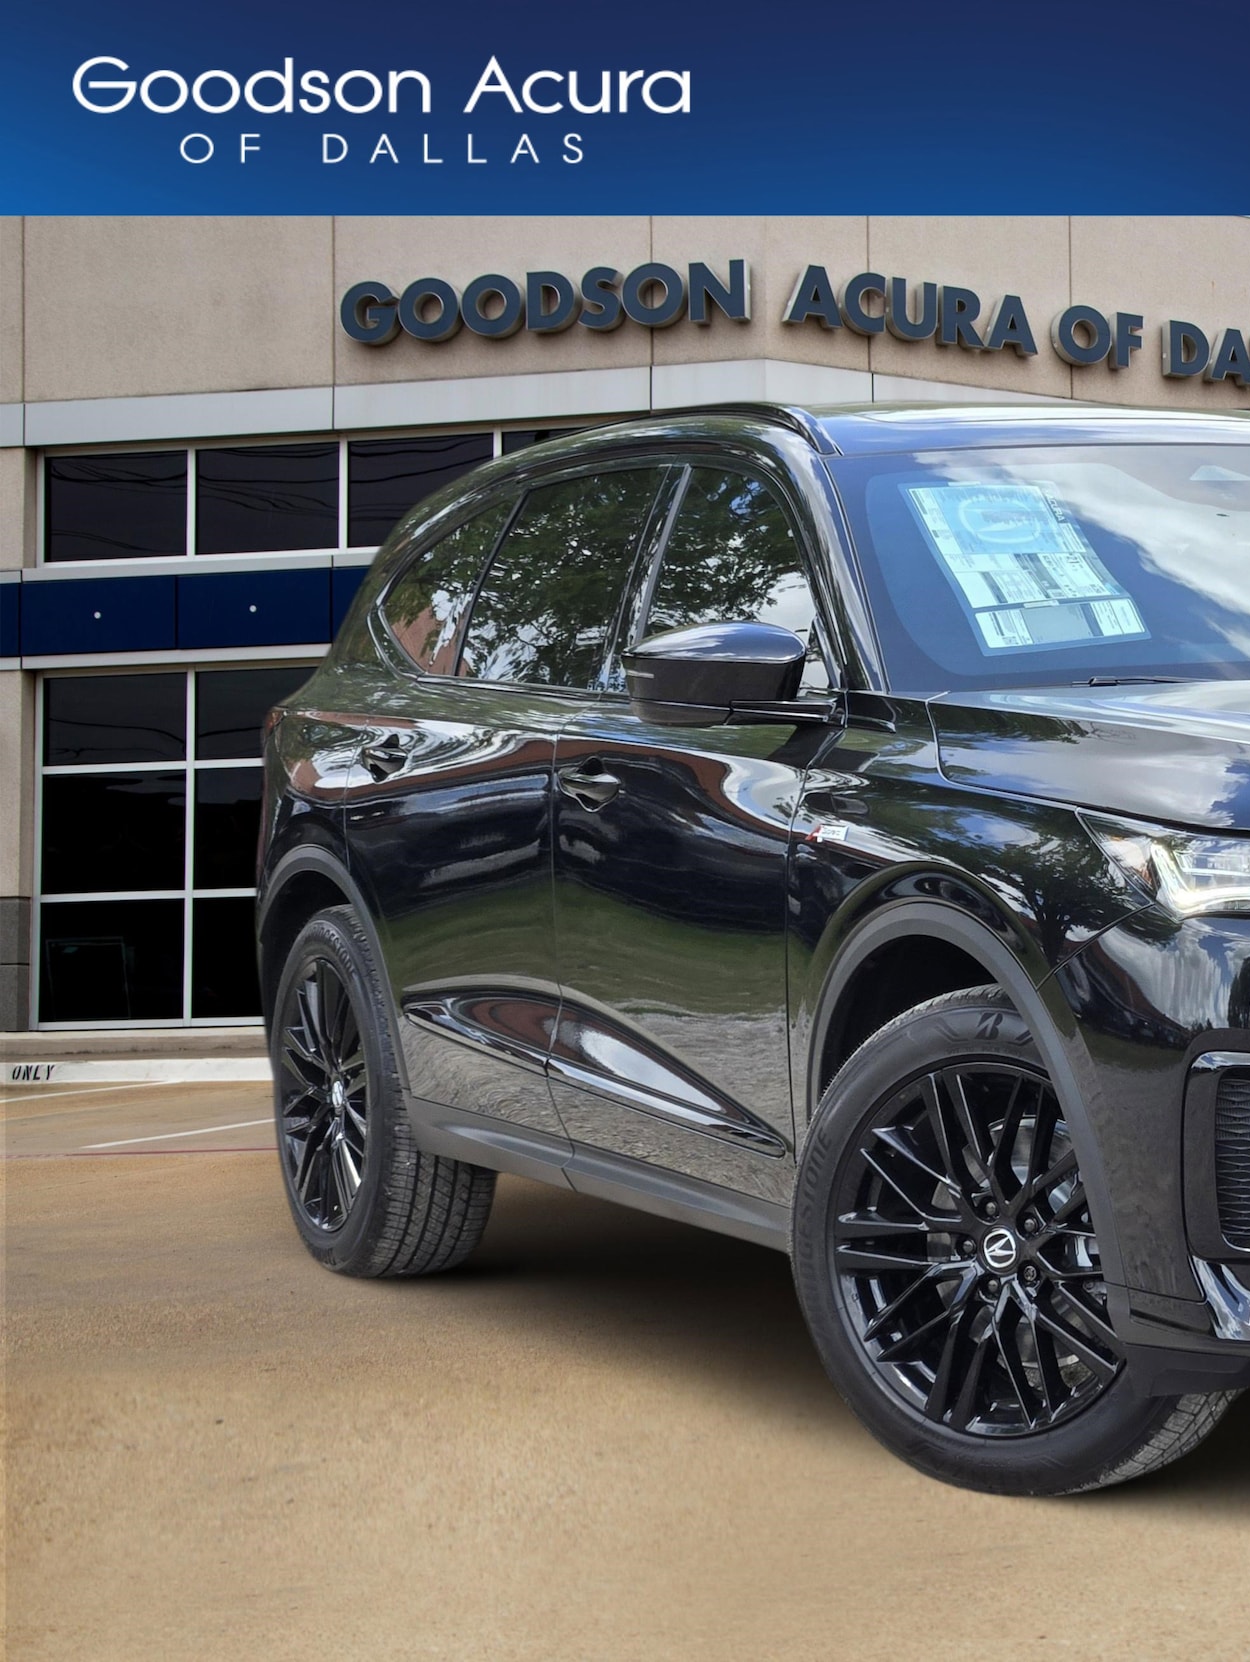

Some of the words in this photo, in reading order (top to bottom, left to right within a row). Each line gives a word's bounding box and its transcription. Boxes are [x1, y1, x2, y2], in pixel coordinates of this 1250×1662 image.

[340, 258, 751, 345] GOODSON
[783, 264, 1038, 357] ACURA
[1052, 305, 1143, 369] OF
[12, 1064, 56, 1081] ONLY
[797, 1125, 833, 1328] DGESTONE
